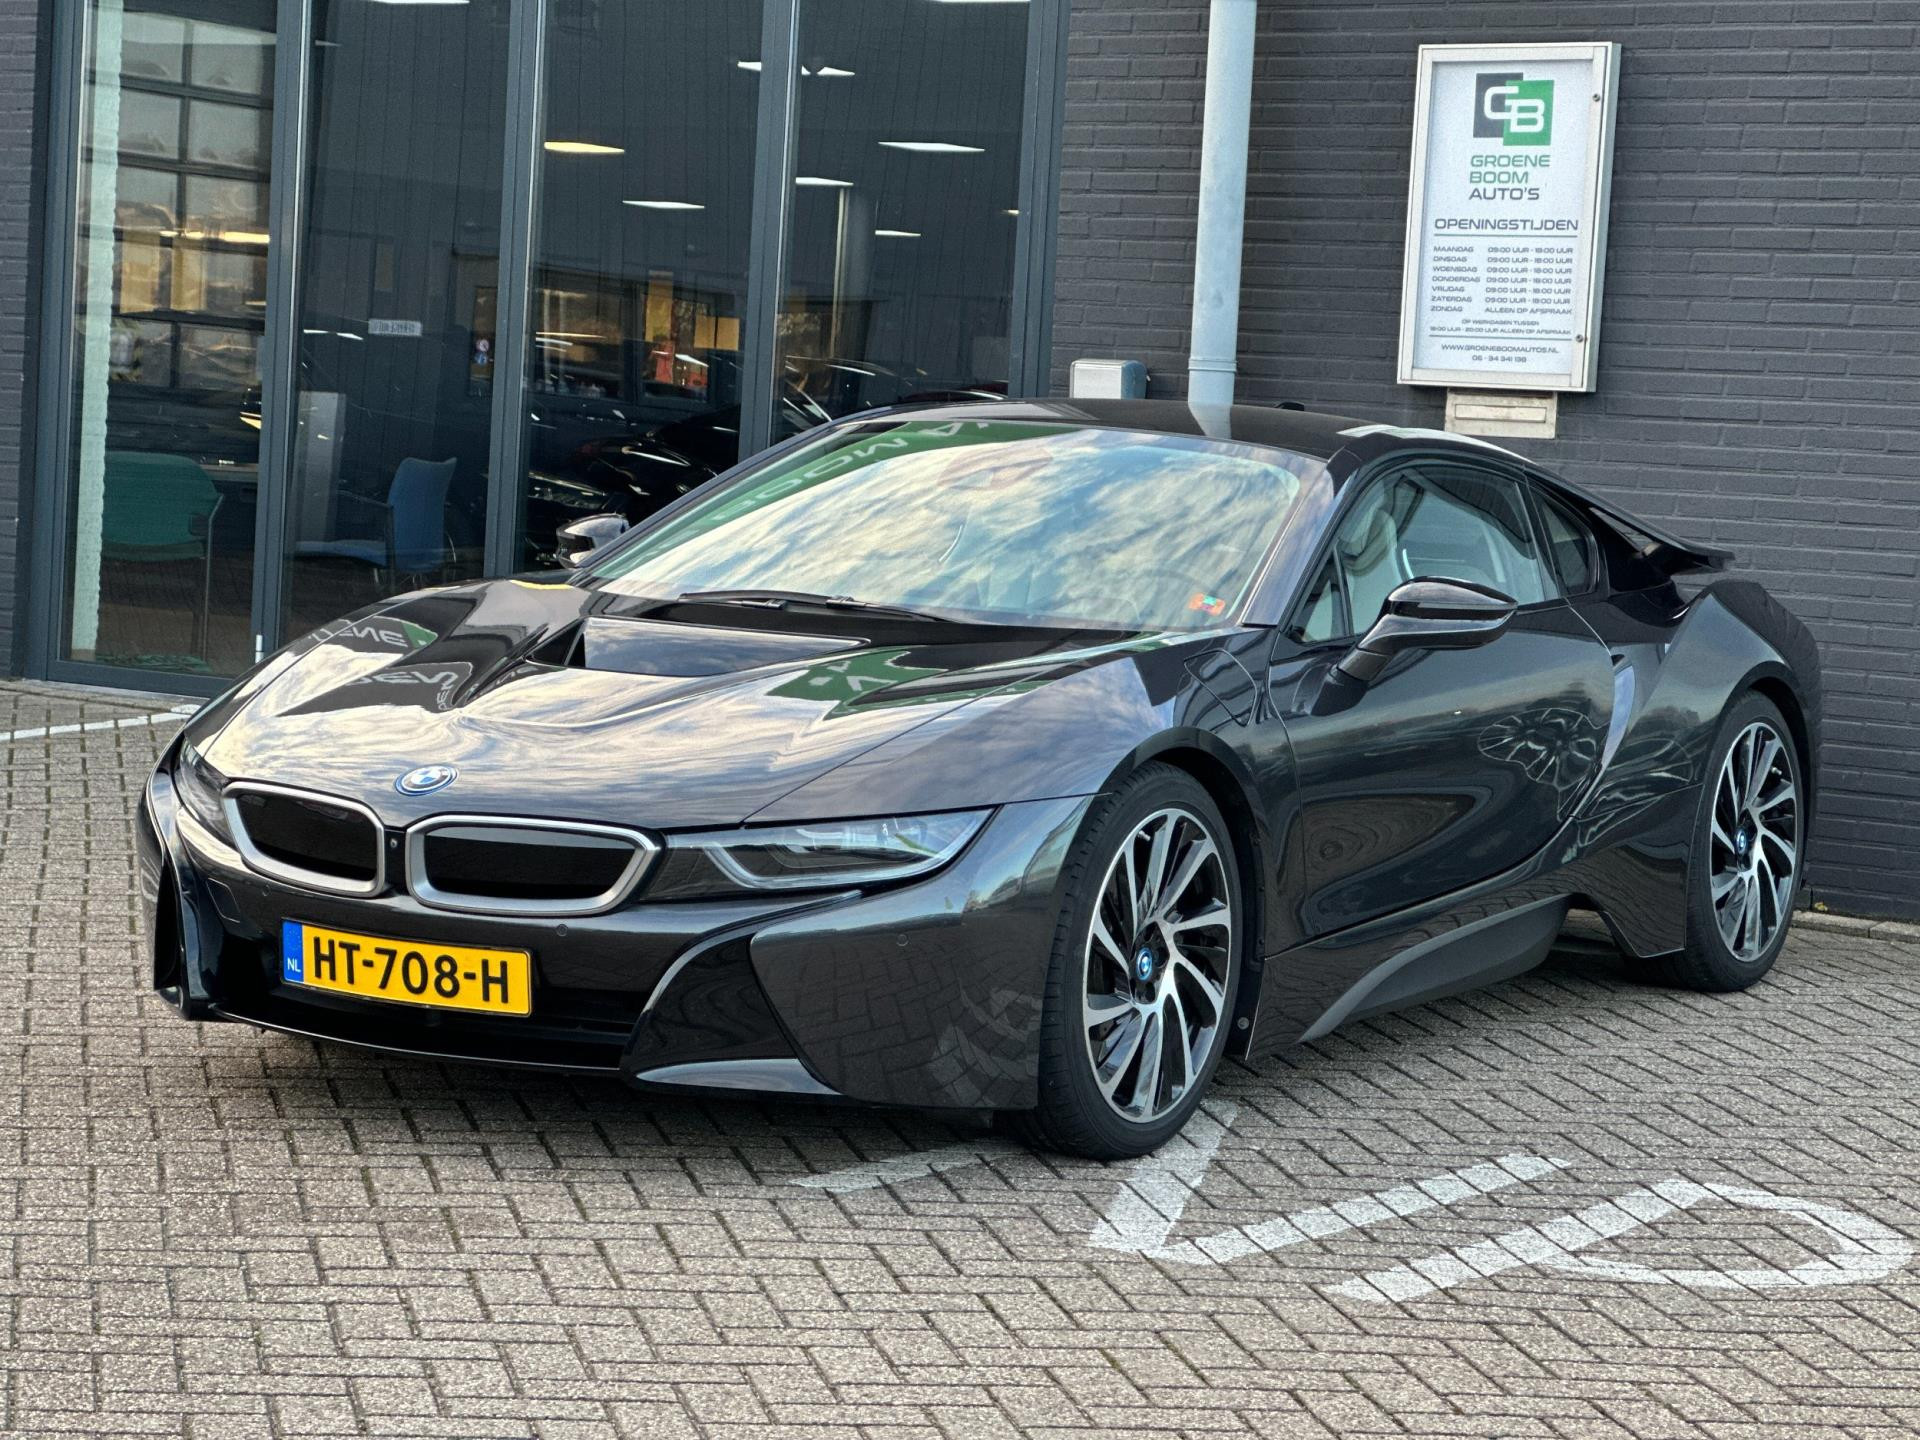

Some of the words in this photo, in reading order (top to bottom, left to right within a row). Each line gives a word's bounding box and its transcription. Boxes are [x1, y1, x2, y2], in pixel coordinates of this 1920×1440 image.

[1470, 154, 1551, 167] GROENE
[1469, 171, 1529, 184] BOOM
[1468, 187, 1540, 200] AUTO'S
[1434, 218, 1579, 231] OPENINGSTIJDEN
[1432, 275, 1481, 283] DONDERDAG
[1431, 295, 1473, 303] ZATERDAG
[287, 958, 301, 973] NL
[313, 936, 509, 1004] HT-708-H
